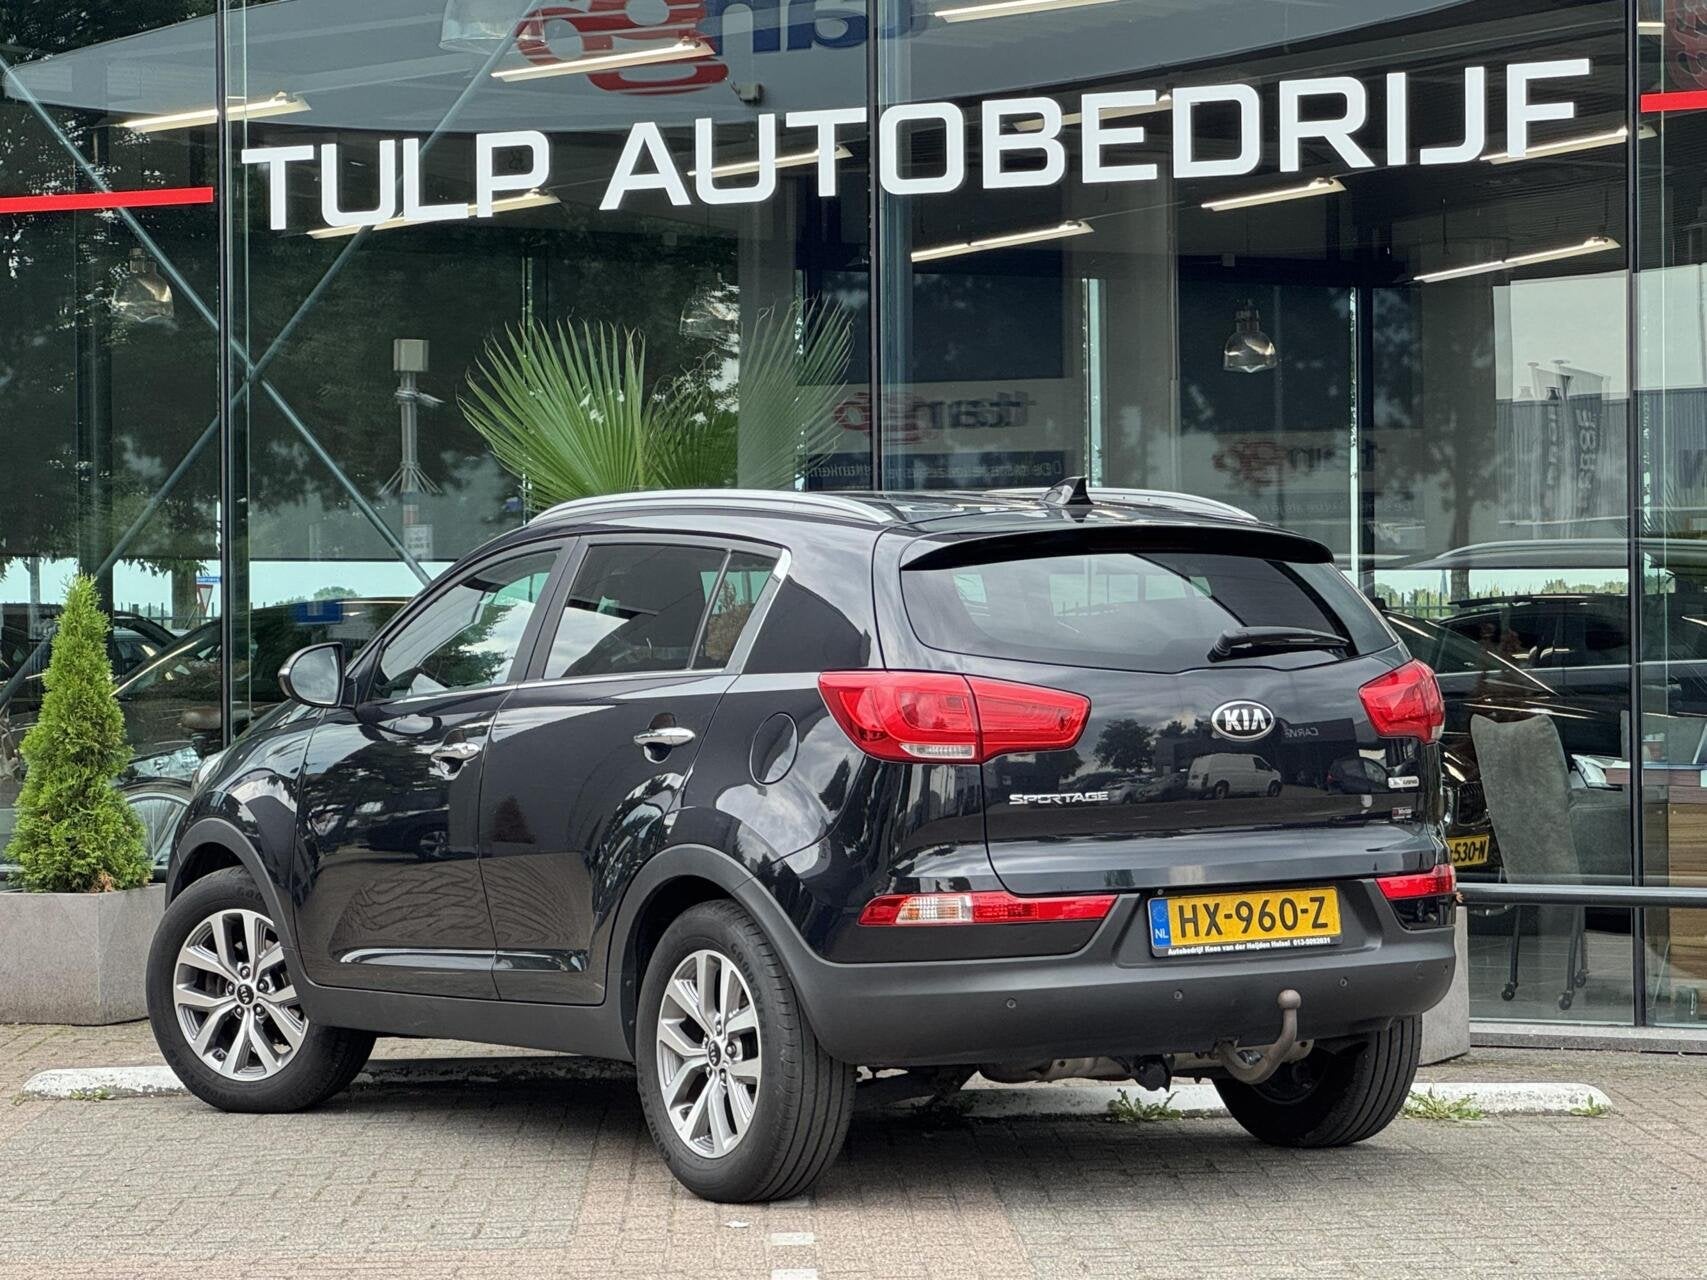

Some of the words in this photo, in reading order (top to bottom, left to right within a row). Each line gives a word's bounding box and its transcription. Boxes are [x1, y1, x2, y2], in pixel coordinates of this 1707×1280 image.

[241, 129, 550, 231] TULP
[600, 58, 1591, 211] AUTOBEDRIJF
[1223, 708, 1267, 731] KIA
[1008, 791, 1109, 805] SPORTAGE
[1177, 896, 1329, 938] HX-960-Z
[1155, 928, 1169, 939] NL
[1167, 945, 1204, 956] Autobedrijf
